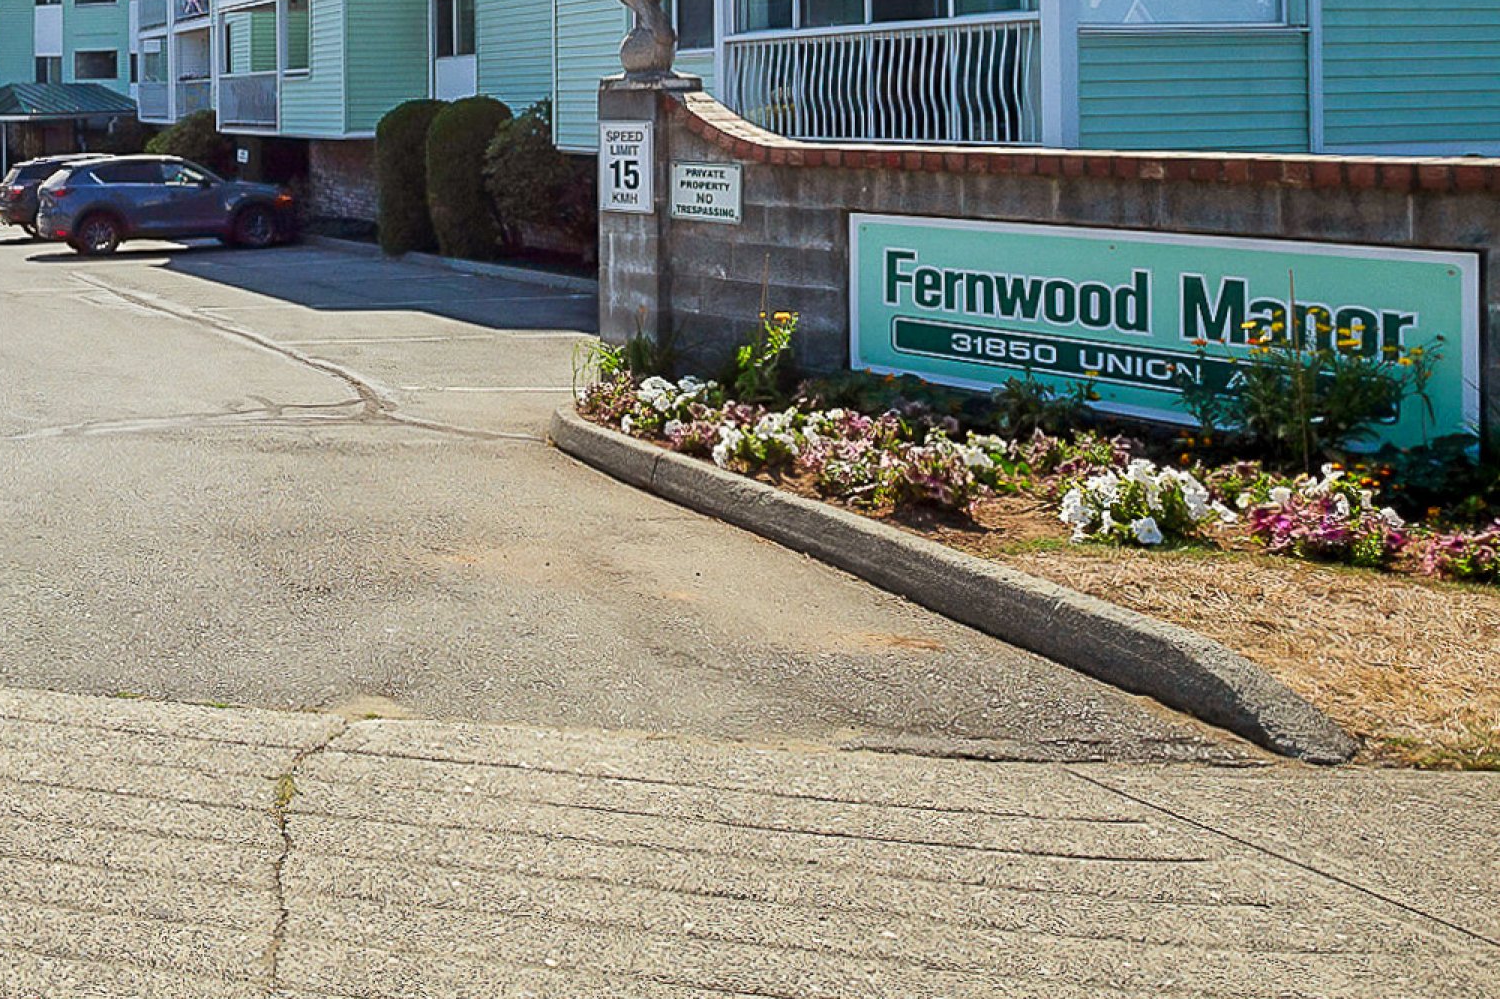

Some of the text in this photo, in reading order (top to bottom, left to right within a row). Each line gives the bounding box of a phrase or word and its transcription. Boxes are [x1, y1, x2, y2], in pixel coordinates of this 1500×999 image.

[606, 131, 643, 142] SPEED
[610, 145, 639, 156] LIMIT
[609, 160, 640, 190] 15
[685, 168, 725, 179] PRIVATE
[680, 180, 730, 191] PROPERTY
[612, 193, 638, 204] KMH
[696, 193, 713, 204] NO
[676, 204, 735, 218] TRESPASSING
[884, 247, 1418, 363] Fernwood Manor
[951, 333, 1203, 385] 31850 UNION
